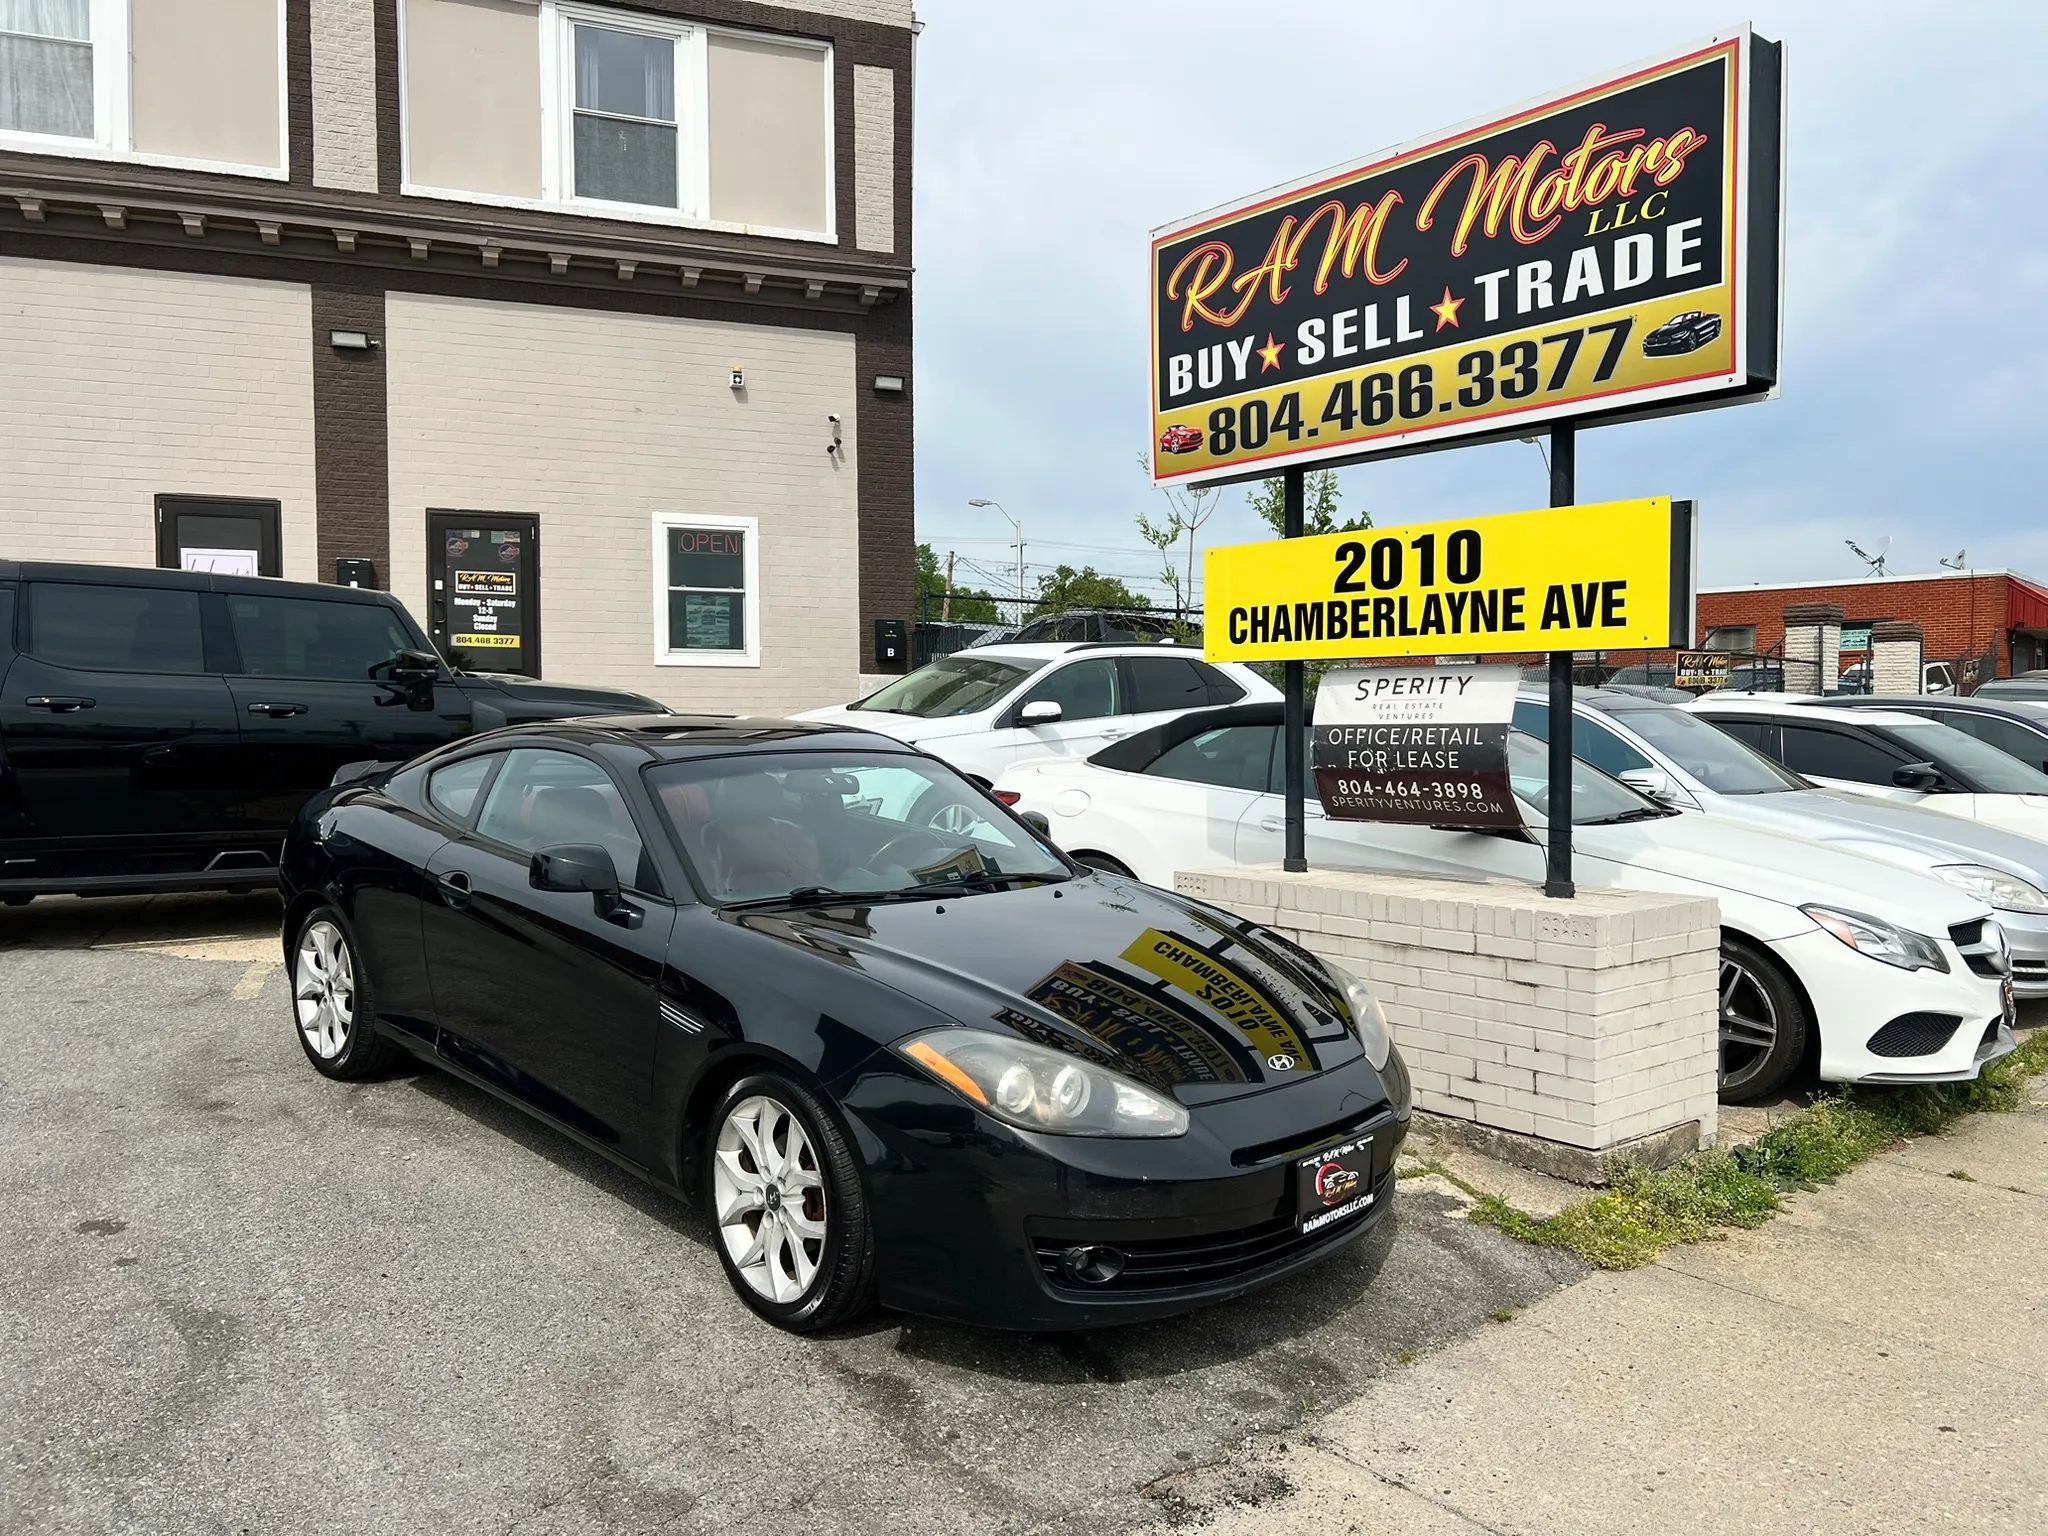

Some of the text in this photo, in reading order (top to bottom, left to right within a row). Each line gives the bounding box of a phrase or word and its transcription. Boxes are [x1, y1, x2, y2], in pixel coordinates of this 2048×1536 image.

[1584, 191, 1669, 236] LLC
[1167, 122, 1708, 332] RAM Motors
[1169, 217, 1702, 397] BUY SELL TRADE
[1208, 317, 1634, 457] 804.466.3377
[680, 532, 739, 554] OPEN
[1333, 529, 1482, 594] 2010
[454, 597, 481, 607] Monday
[486, 598, 516, 608] Saturday
[1229, 579, 1627, 645] CHAMBERLAYNE AVE
[472, 614, 498, 623] Sunday
[473, 622, 497, 631] Closed
[887, 648, 895, 657] B
[1355, 676, 1473, 701] SPERITY
[1378, 712, 1434, 720] VENTURES
[1405, 702, 1444, 710] ESTATE
[1328, 727, 1483, 745] OFFICE/RETAIL
[1348, 750, 1460, 769] FOR LEASE
[1337, 779, 1483, 800] 804-464-3898
[1331, 795, 1504, 814] SPERITYVENTURES.COM
